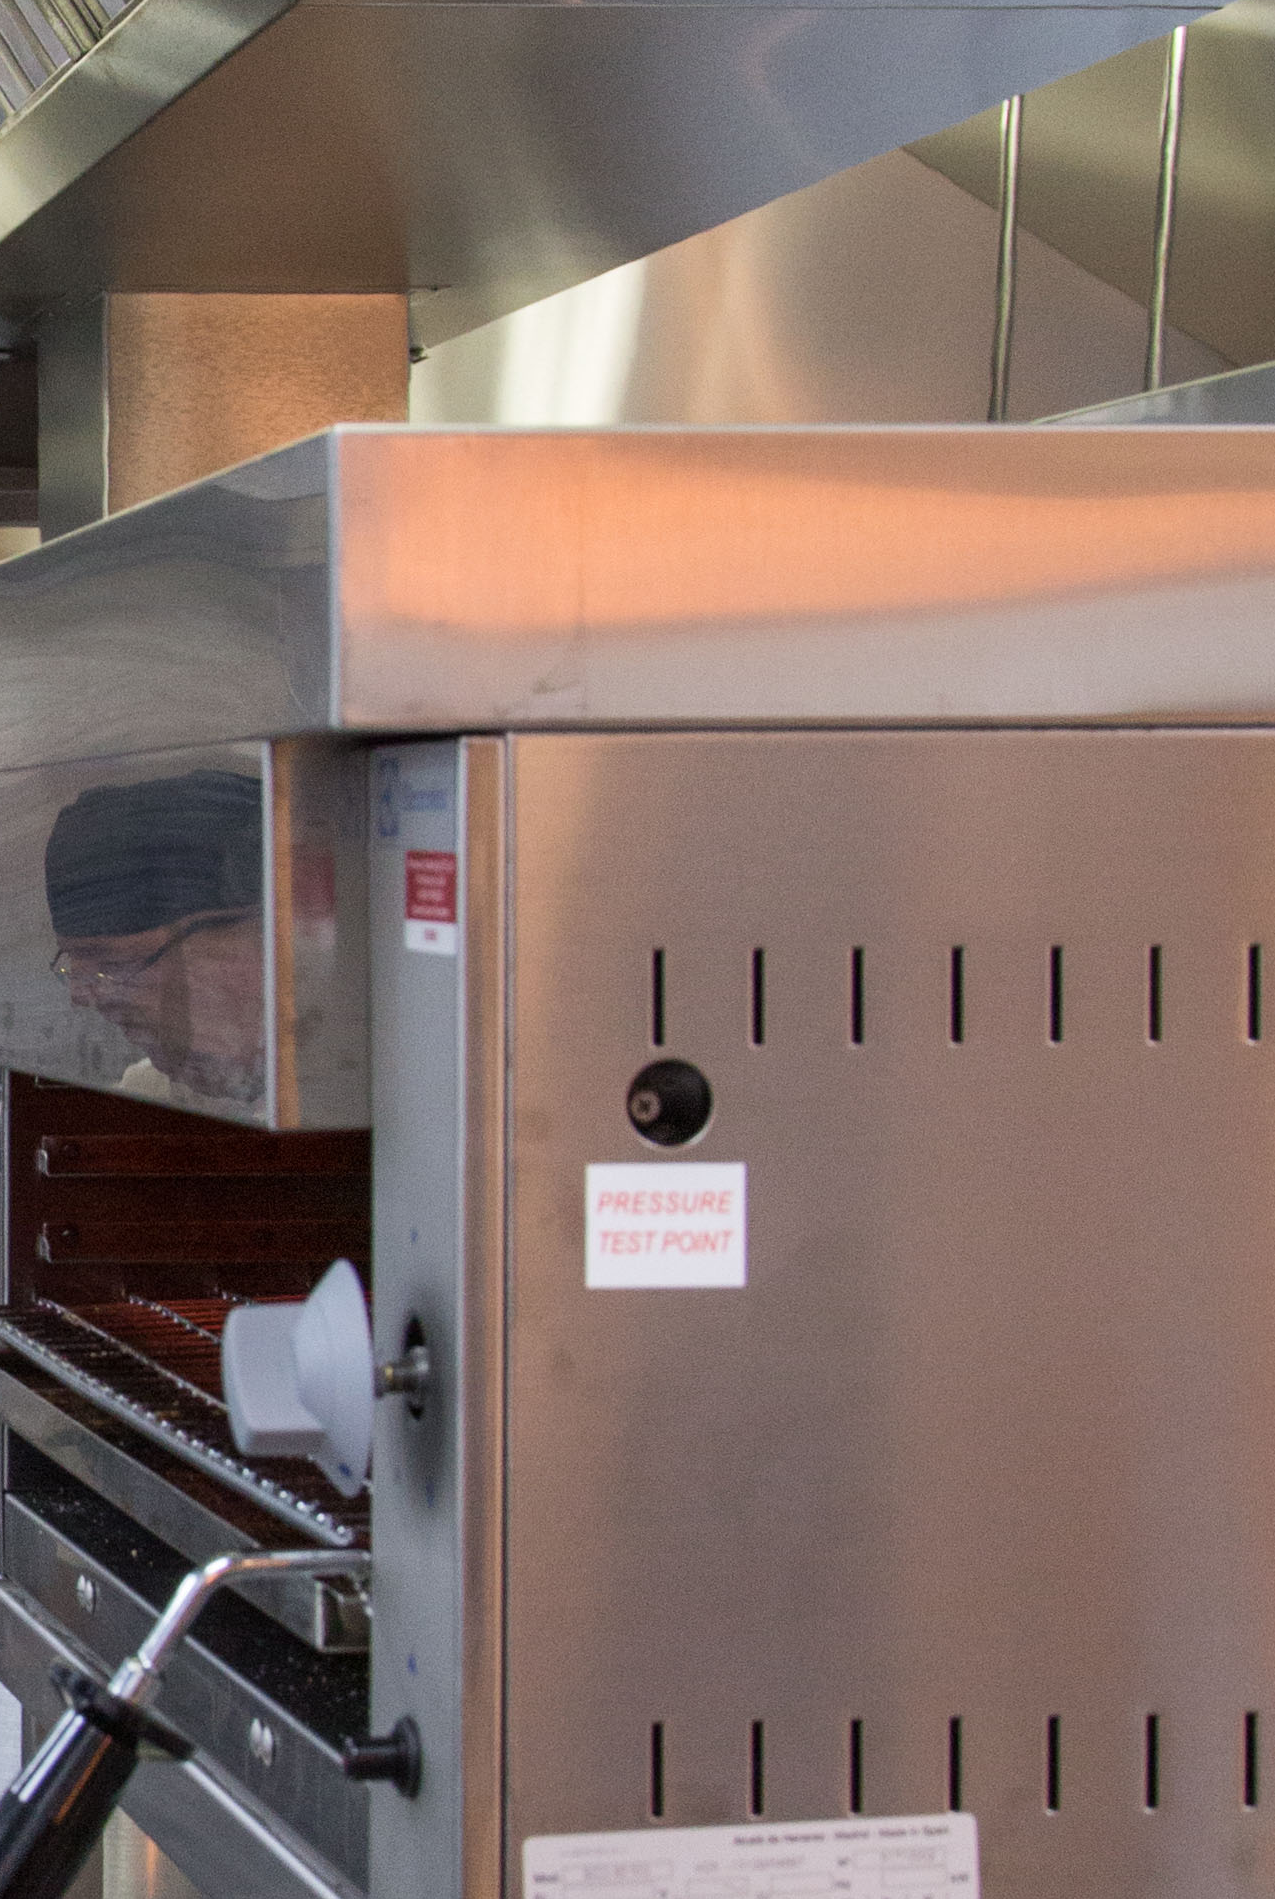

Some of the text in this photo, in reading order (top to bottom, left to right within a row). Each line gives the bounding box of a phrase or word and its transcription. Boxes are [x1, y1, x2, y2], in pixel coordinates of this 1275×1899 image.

[597, 1190, 733, 1215] PRESSURE
[600, 1230, 733, 1255] TEST POINT
